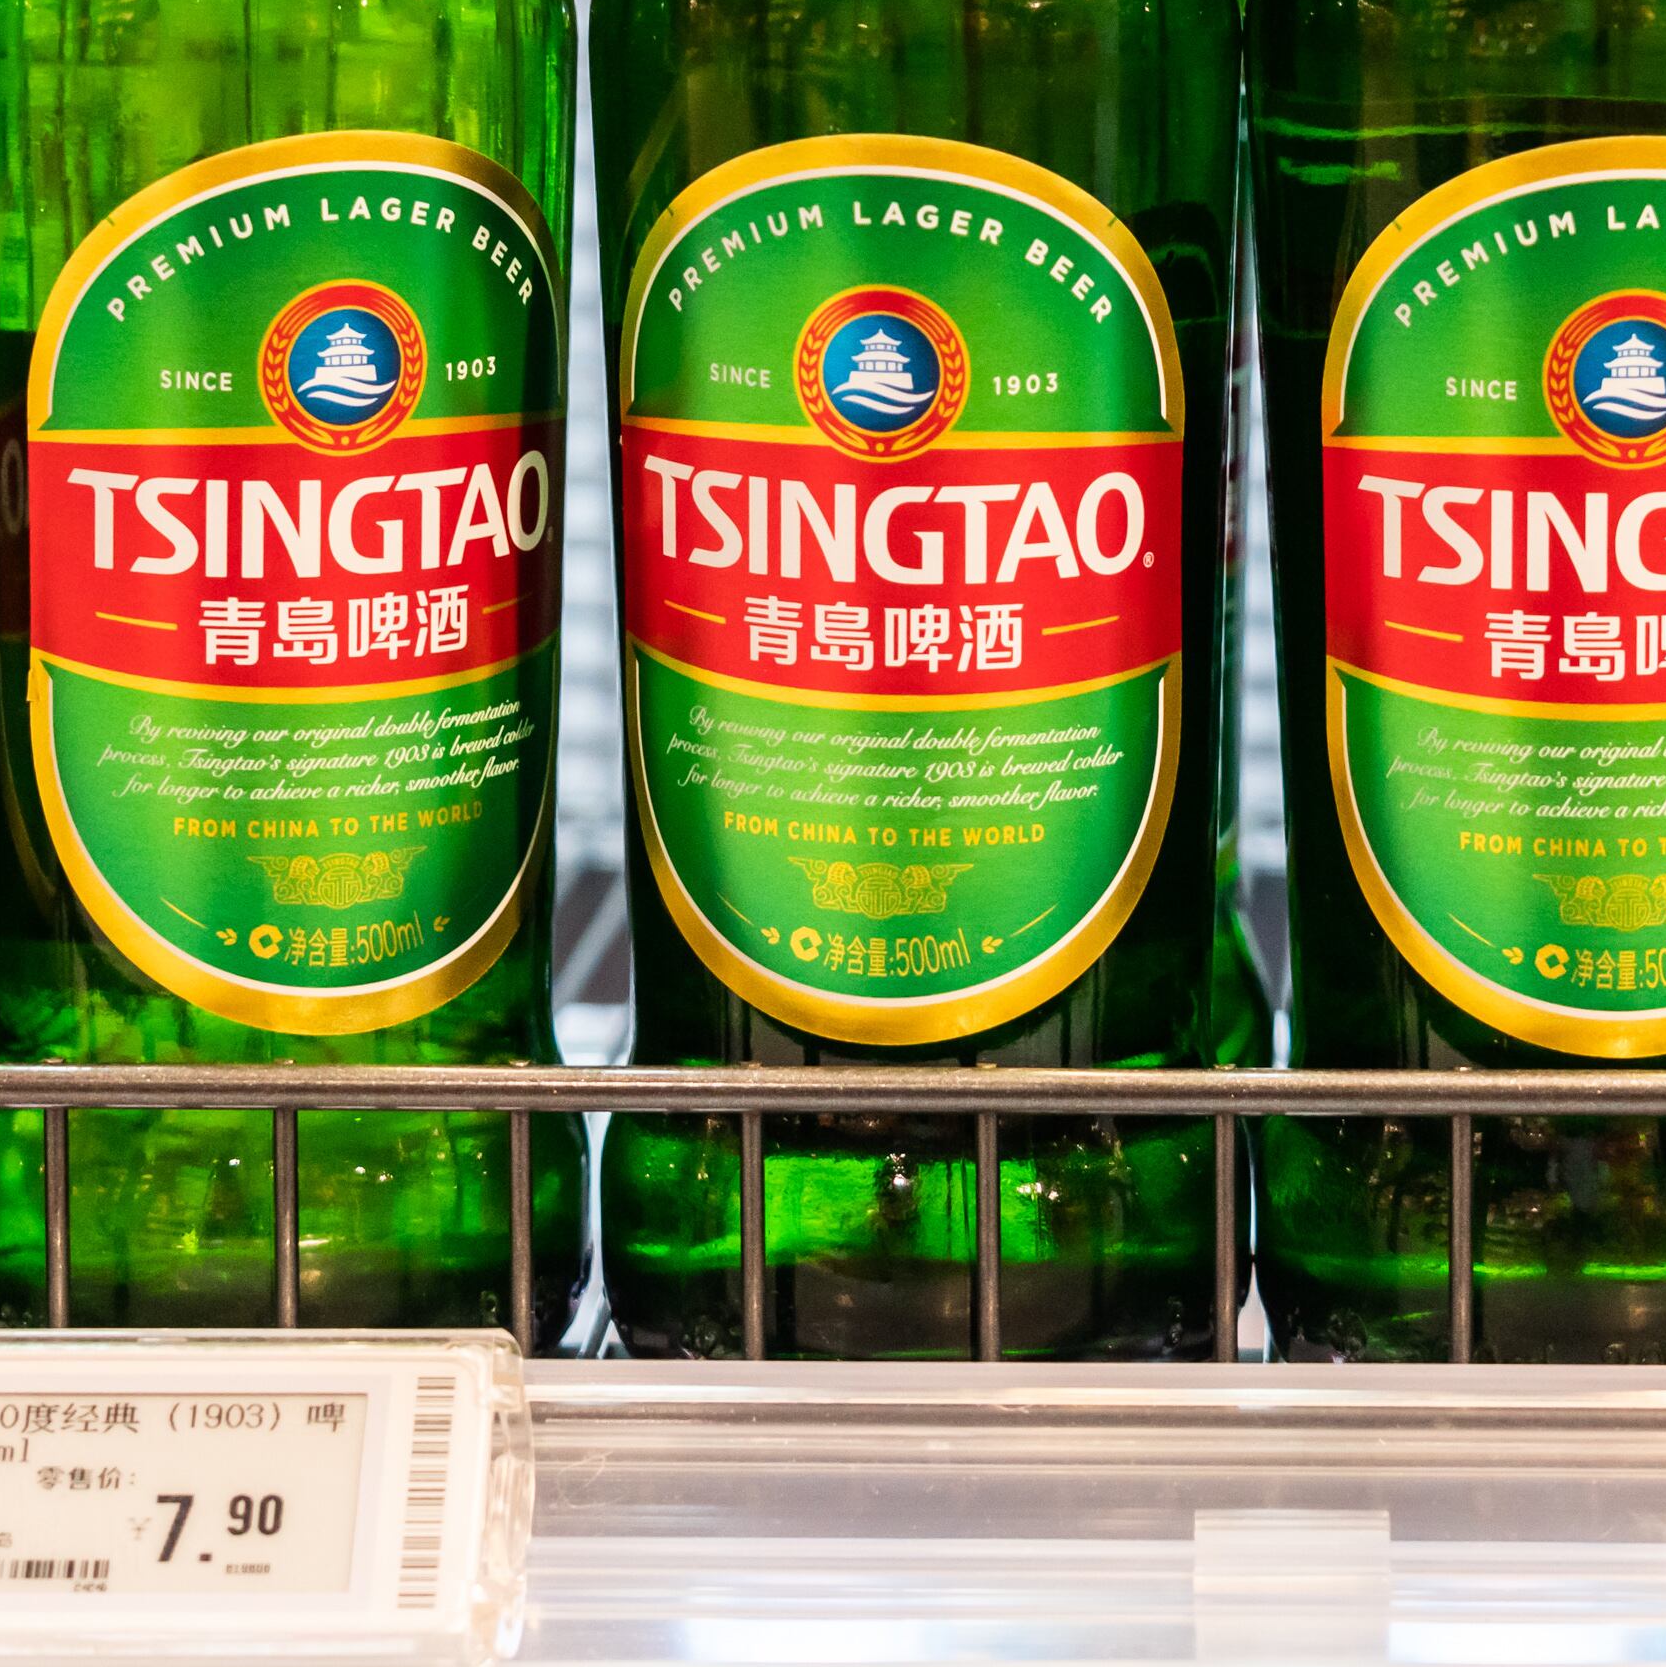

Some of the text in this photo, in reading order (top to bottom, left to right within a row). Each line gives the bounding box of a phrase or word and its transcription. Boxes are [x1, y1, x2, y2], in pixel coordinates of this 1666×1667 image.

[107, 196, 532, 322] PREMIUM LAGER BEER
[669, 201, 1111, 324] PREMIUM LAGER BEER
[1394, 212, 1577, 328] PREMIUM
[160, 356, 495, 391] SINCE 1903
[710, 363, 1057, 395] SINCE 1903
[1446, 377, 1517, 401] SINCE
[67, 451, 548, 578] TSINGTAO
[643, 454, 1145, 585] TSINGTAO
[199, 585, 469, 665] 青島啤酒
[744, 595, 1024, 673] 青島啤酒
[130, 700, 520, 749] By reviving our original double fermentation
[286, 753, 377, 778] signature
[384, 744, 430, 769] 1903
[432, 742, 444, 759] is
[450, 733, 501, 758] brewed
[112, 772, 153, 798] for
[157, 777, 221, 804] longer
[224, 787, 245, 801] to
[250, 778, 323, 801] achieve
[327, 786, 343, 798] a
[405, 769, 481, 790] smoother
[174, 803, 483, 838] FROM CHINA TO THE WORLD
[725, 811, 1044, 847] FROM CHINA TO THE WORLD
[1460, 831, 1522, 854] FROM
[1533, 837, 1606, 857] CHINA
[1618, 838, 1648, 857] TO
